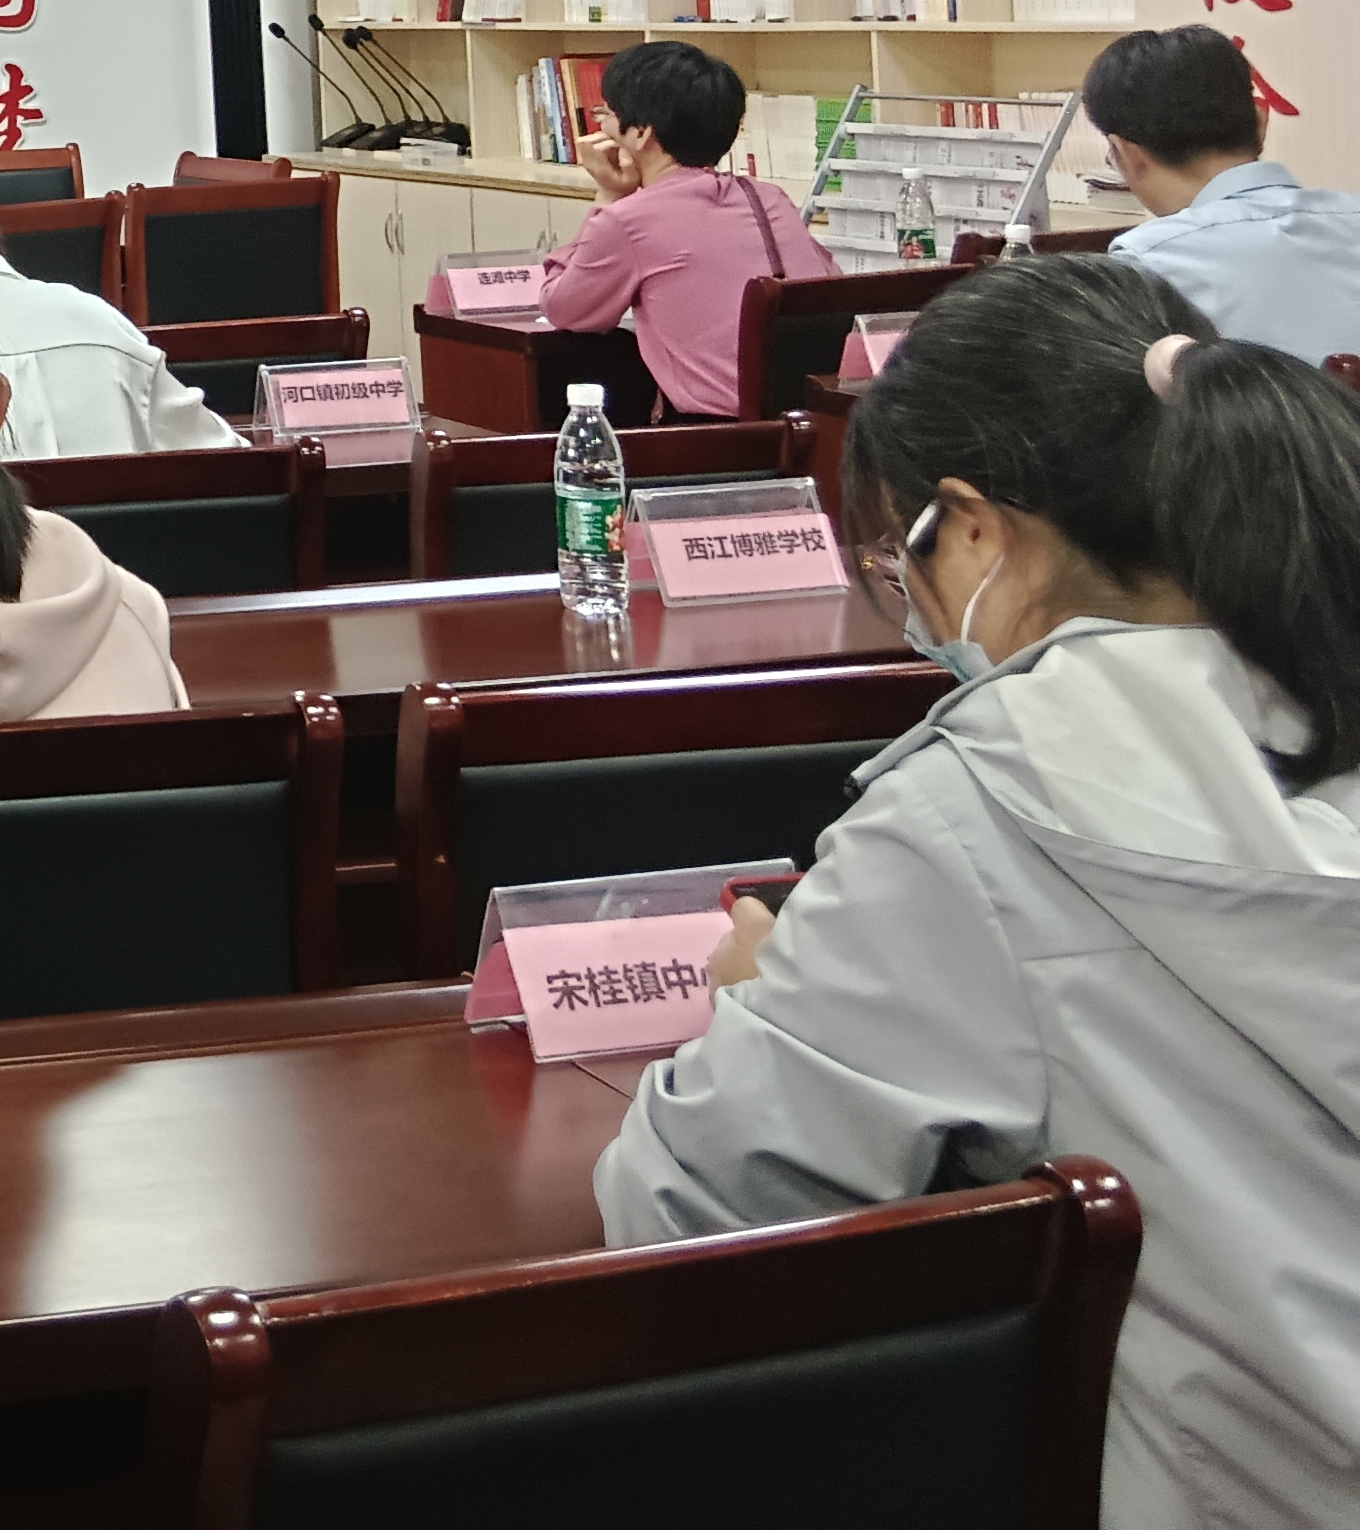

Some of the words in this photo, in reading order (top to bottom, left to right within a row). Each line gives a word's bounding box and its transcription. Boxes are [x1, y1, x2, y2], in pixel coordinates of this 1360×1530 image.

[281, 380, 405, 404] 河口镇初级中学
[682, 527, 827, 562] 西江博雅学校
